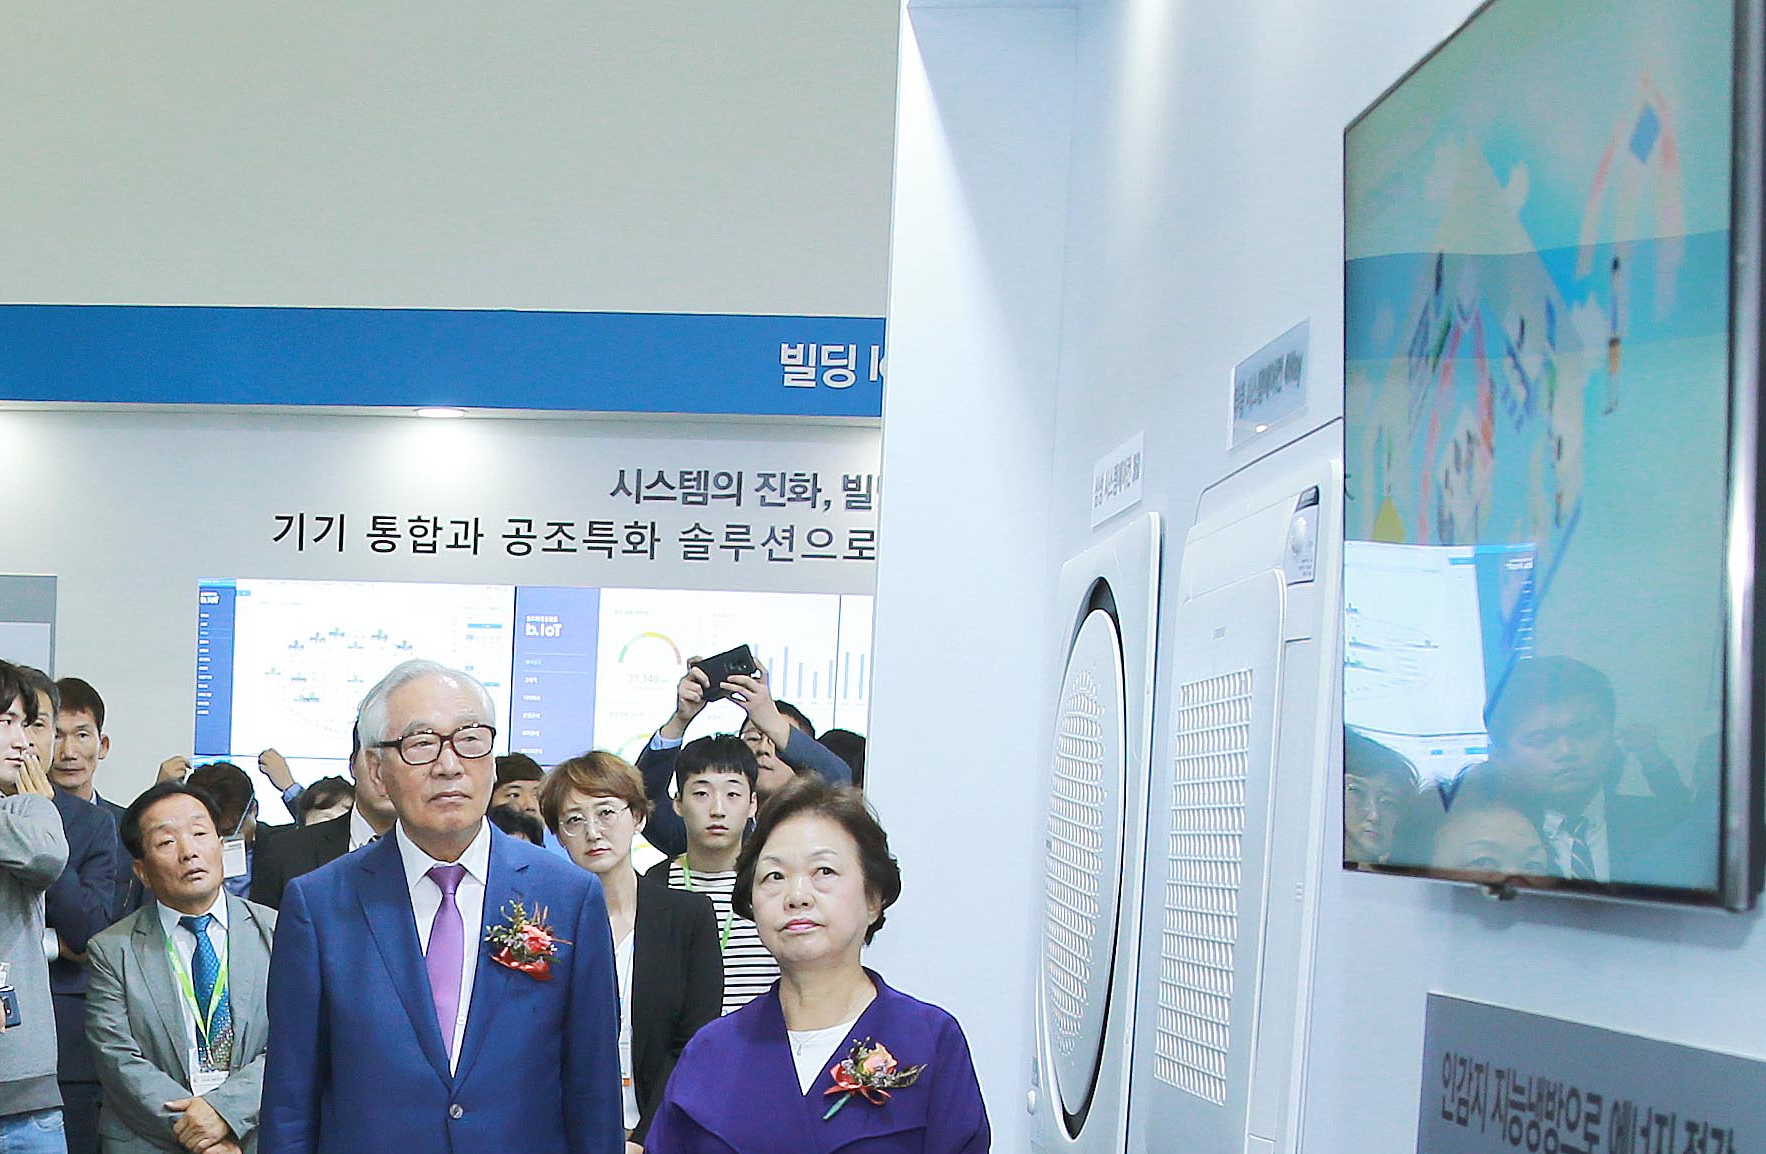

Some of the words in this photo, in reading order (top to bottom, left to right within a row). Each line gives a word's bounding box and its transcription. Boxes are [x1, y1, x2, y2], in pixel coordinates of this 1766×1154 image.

[780, 342, 857, 389] 빌딩
[610, 468, 744, 507] 시스템의
[754, 471, 832, 512] 진화,
[842, 473, 882, 510] 빌
[271, 512, 345, 553] 기기
[366, 514, 484, 556] 통합과
[502, 517, 661, 561] 공조특화
[679, 522, 876, 563] 솔루션으로
[526, 622, 563, 637] b.IoT
[1442, 1052, 1489, 1134] 인감지
